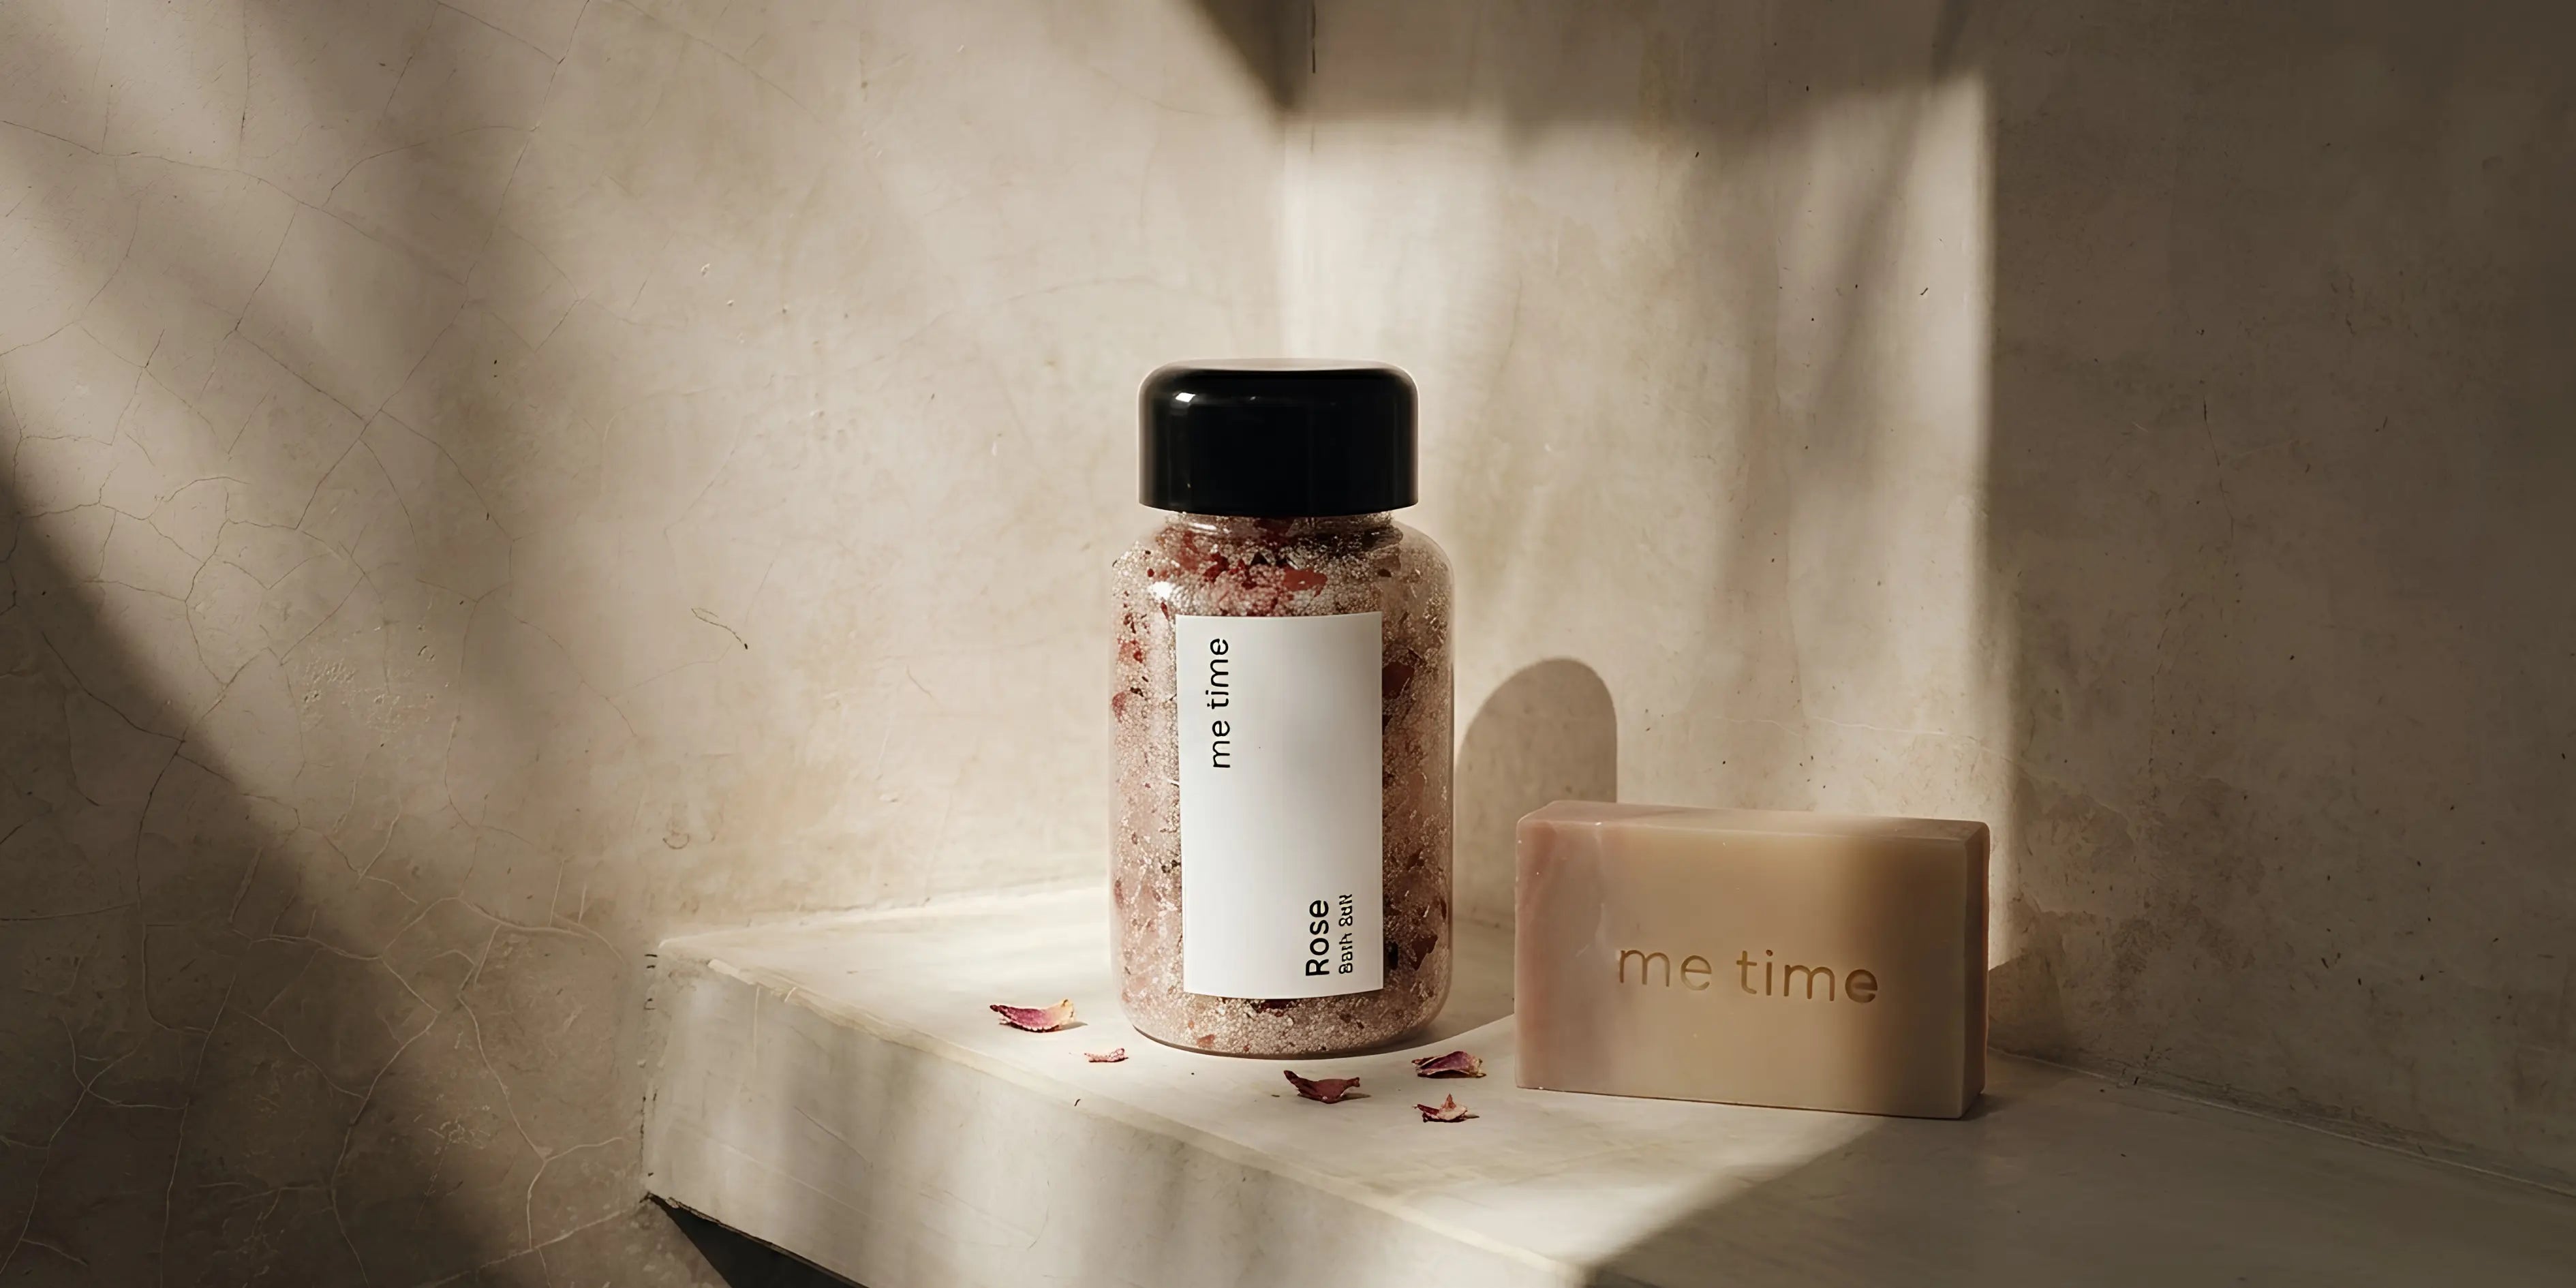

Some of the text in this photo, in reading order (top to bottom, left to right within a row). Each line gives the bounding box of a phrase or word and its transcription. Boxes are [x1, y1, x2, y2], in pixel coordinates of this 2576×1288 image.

[1205, 637, 1231, 769] me time
[1304, 899, 1330, 977] Rose
[1618, 949, 1879, 1004] me time
